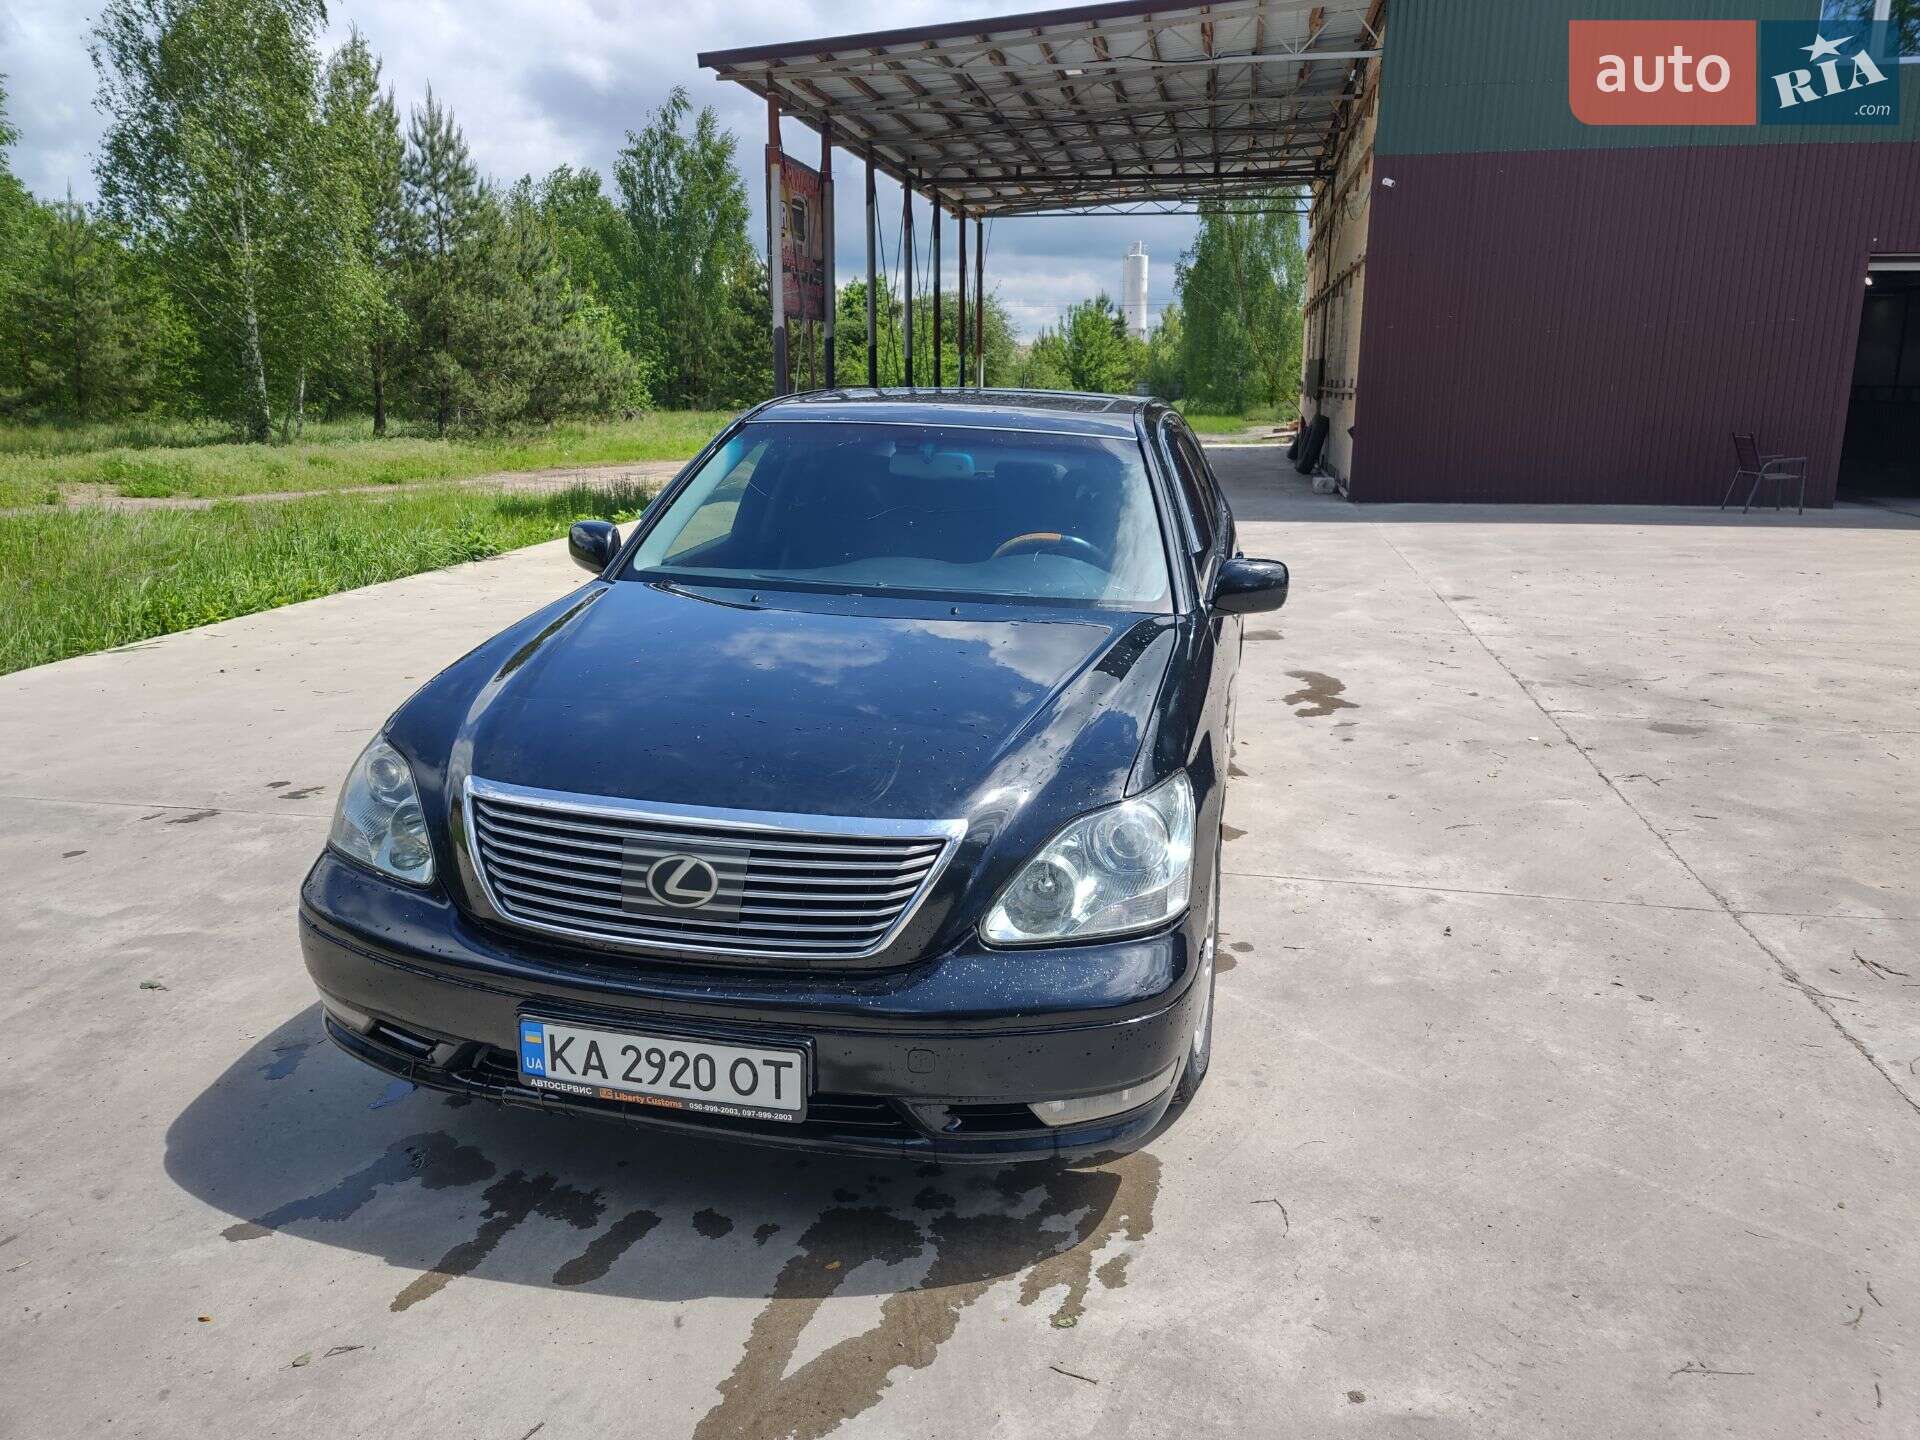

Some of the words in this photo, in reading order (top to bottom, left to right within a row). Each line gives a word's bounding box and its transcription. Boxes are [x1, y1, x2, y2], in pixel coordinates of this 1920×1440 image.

[526, 1057, 543, 1071] UA
[549, 1034, 609, 1080] KA
[620, 1044, 716, 1092] 2920
[729, 1057, 793, 1100] OT
[530, 1078, 593, 1095] АВТОСЕРВИС
[614, 1092, 645, 1104] Liberty
[646, 1096, 683, 1109] Customs
